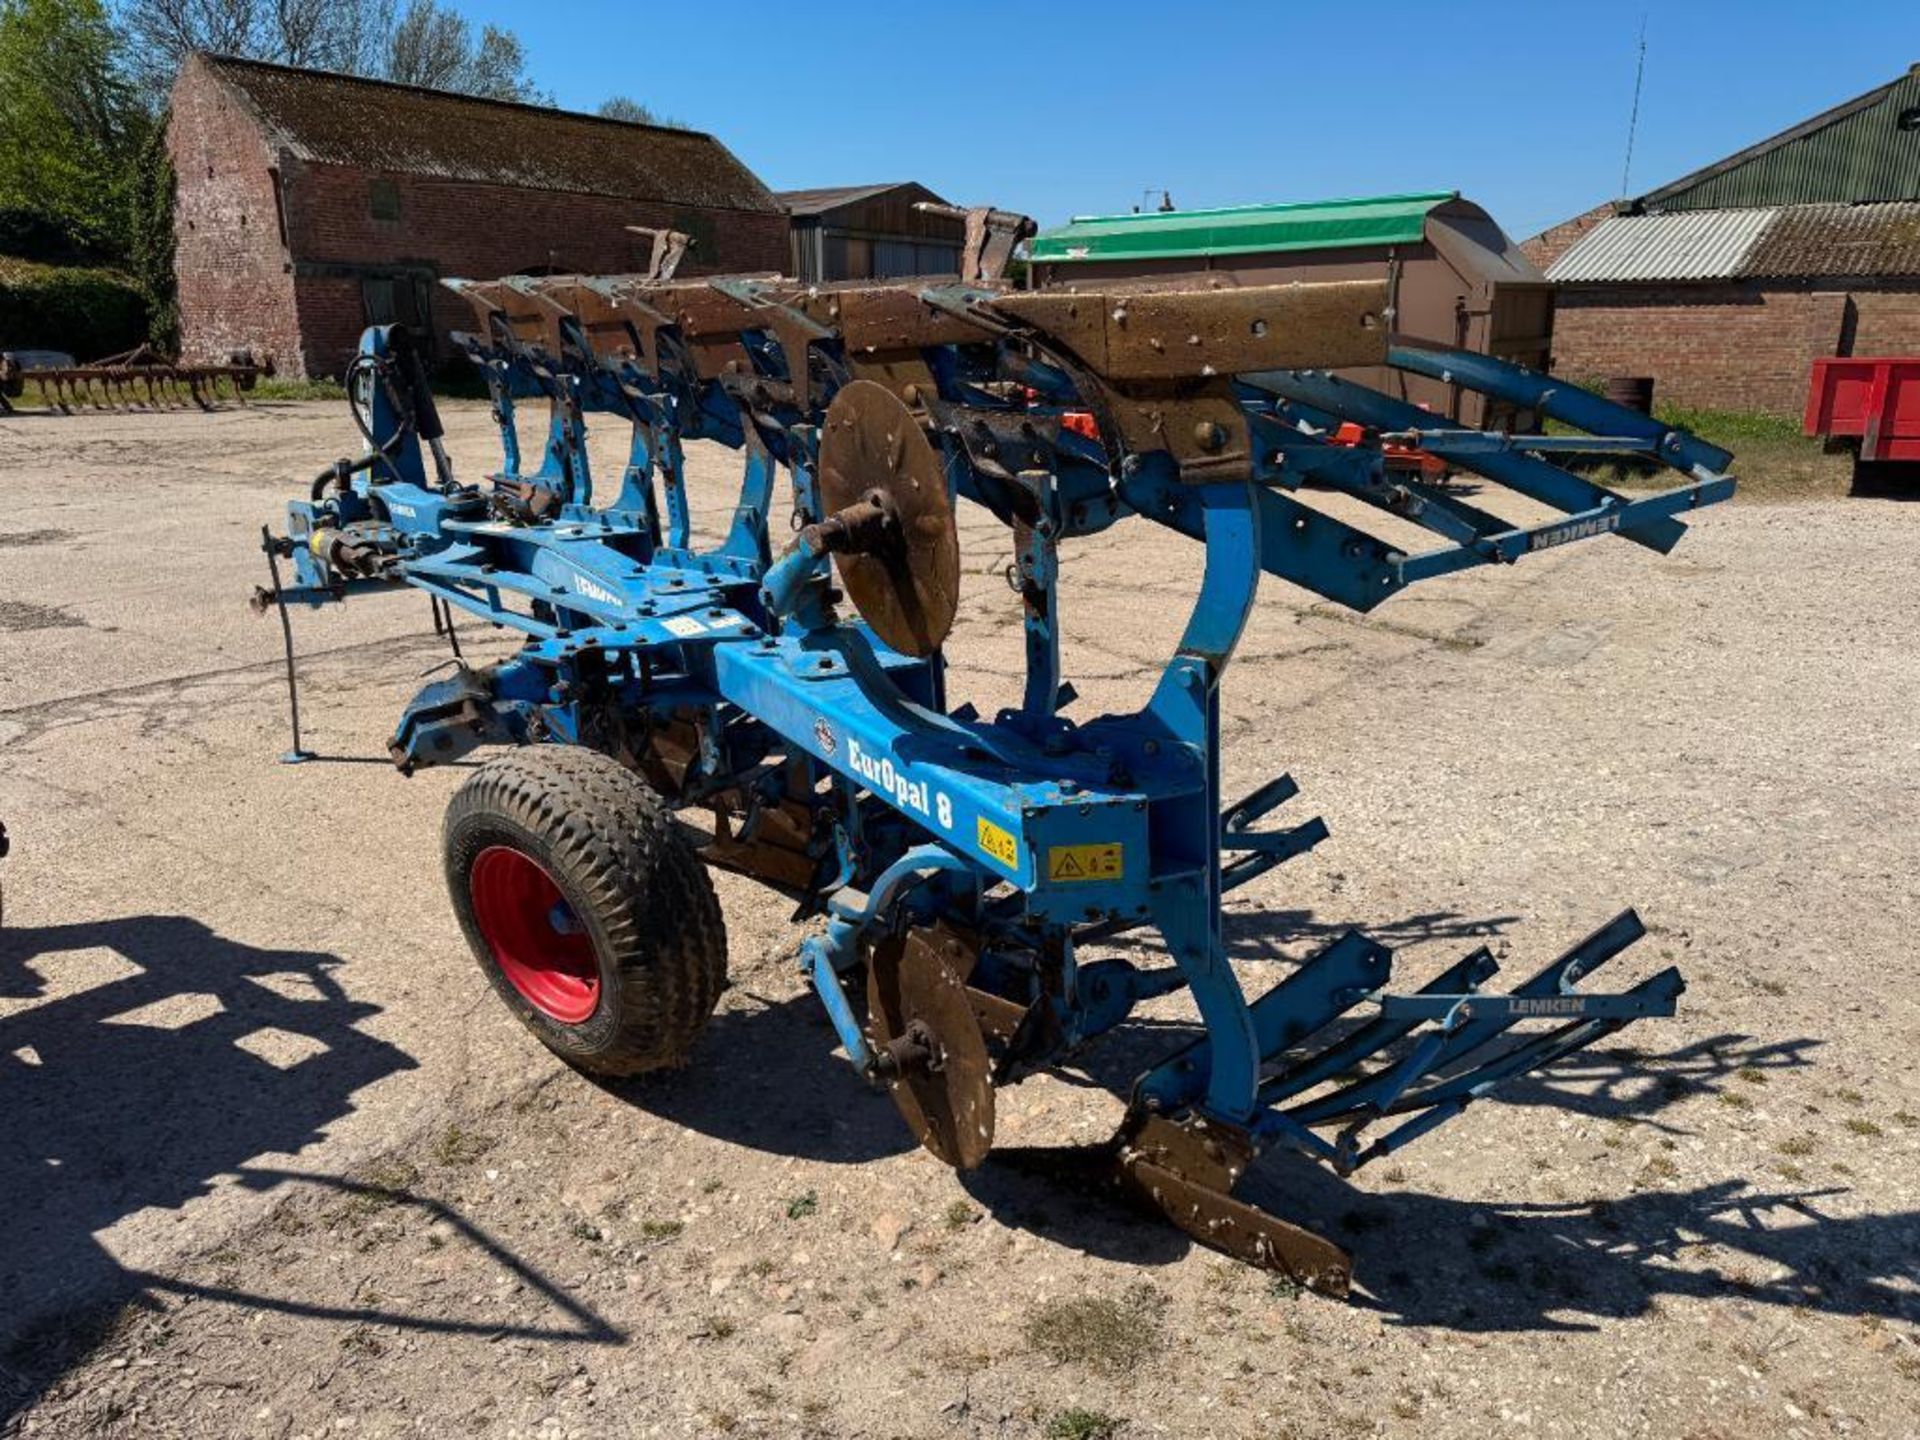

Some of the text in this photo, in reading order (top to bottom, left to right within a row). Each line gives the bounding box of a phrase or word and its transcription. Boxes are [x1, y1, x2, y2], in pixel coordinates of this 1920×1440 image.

[847, 737, 953, 829] EurOpal 8
[1509, 998, 1585, 1014] LEMKEN
